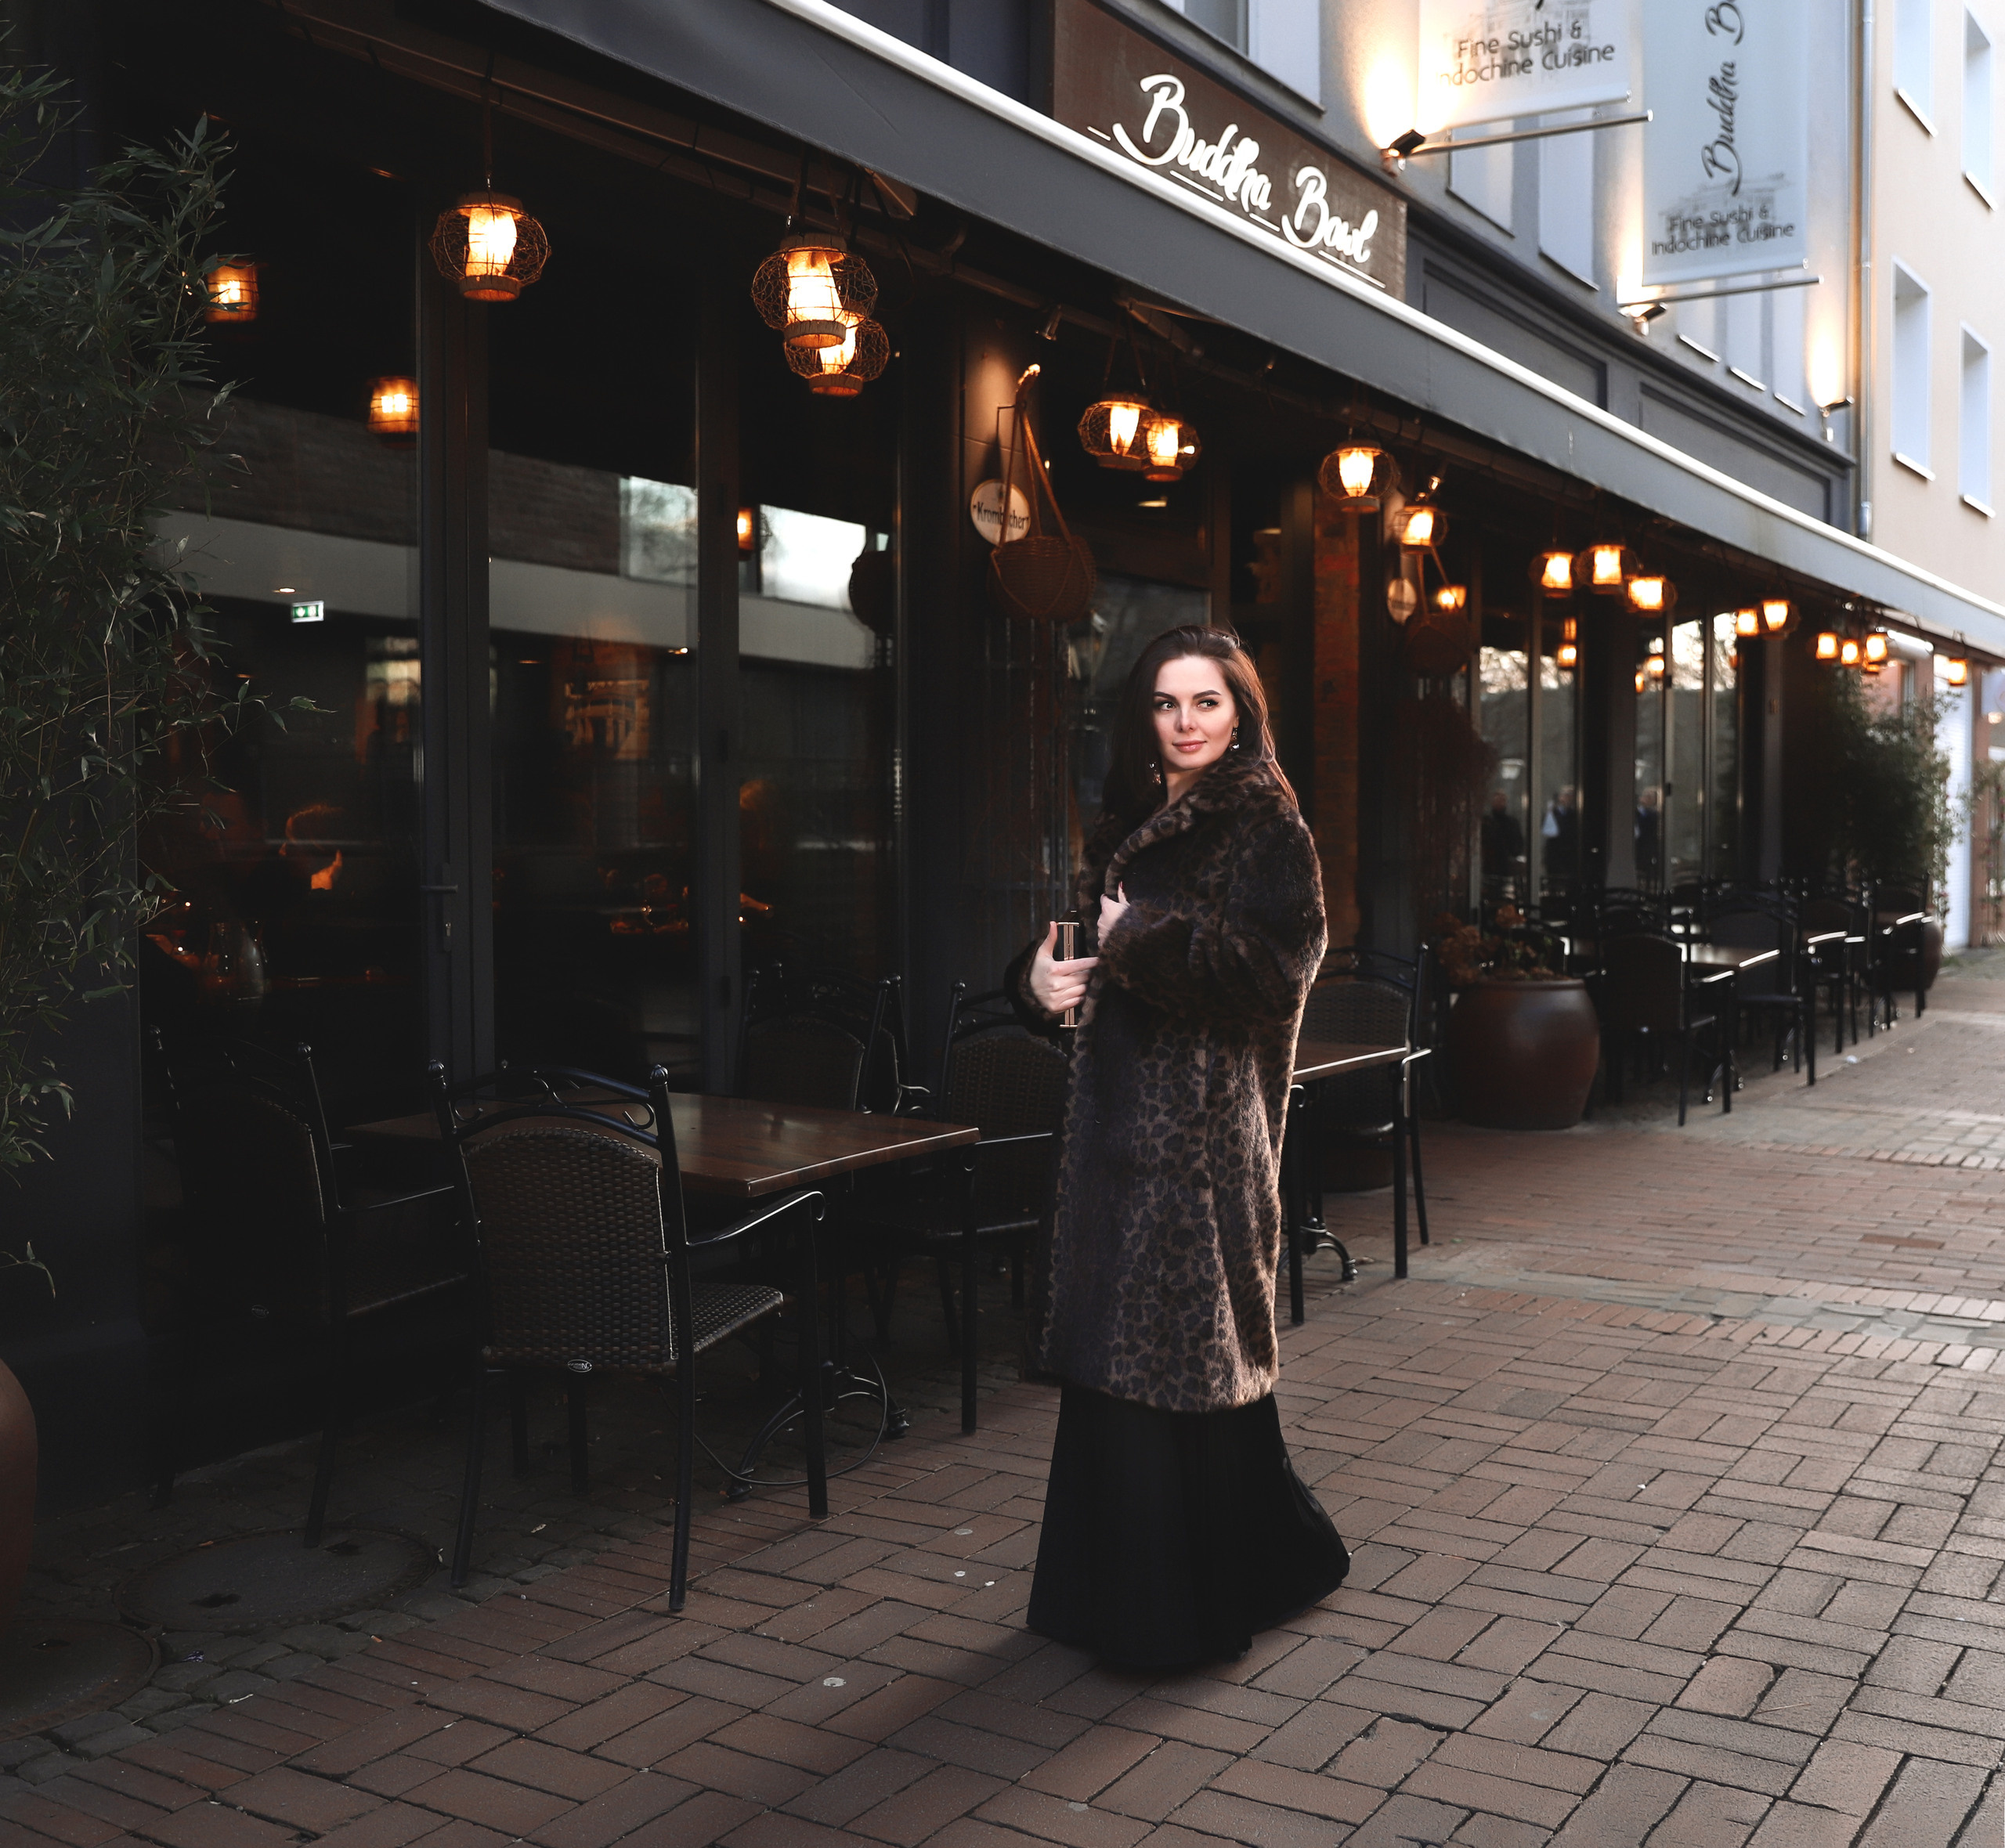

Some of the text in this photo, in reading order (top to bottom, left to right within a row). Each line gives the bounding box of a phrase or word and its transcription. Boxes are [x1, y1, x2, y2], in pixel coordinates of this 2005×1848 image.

[1457, 19, 1582, 58] Fine Sushi &
[1541, 44, 1615, 70] Cuisine
[1701, 0, 1746, 197] Buddha B
[1112, 74, 1378, 264] Buddha Bowl
[1669, 204, 1770, 233] Fine Sushi &
[1652, 222, 1795, 256] Indochine Cuisine
[977, 501, 1025, 529] Krombcher
